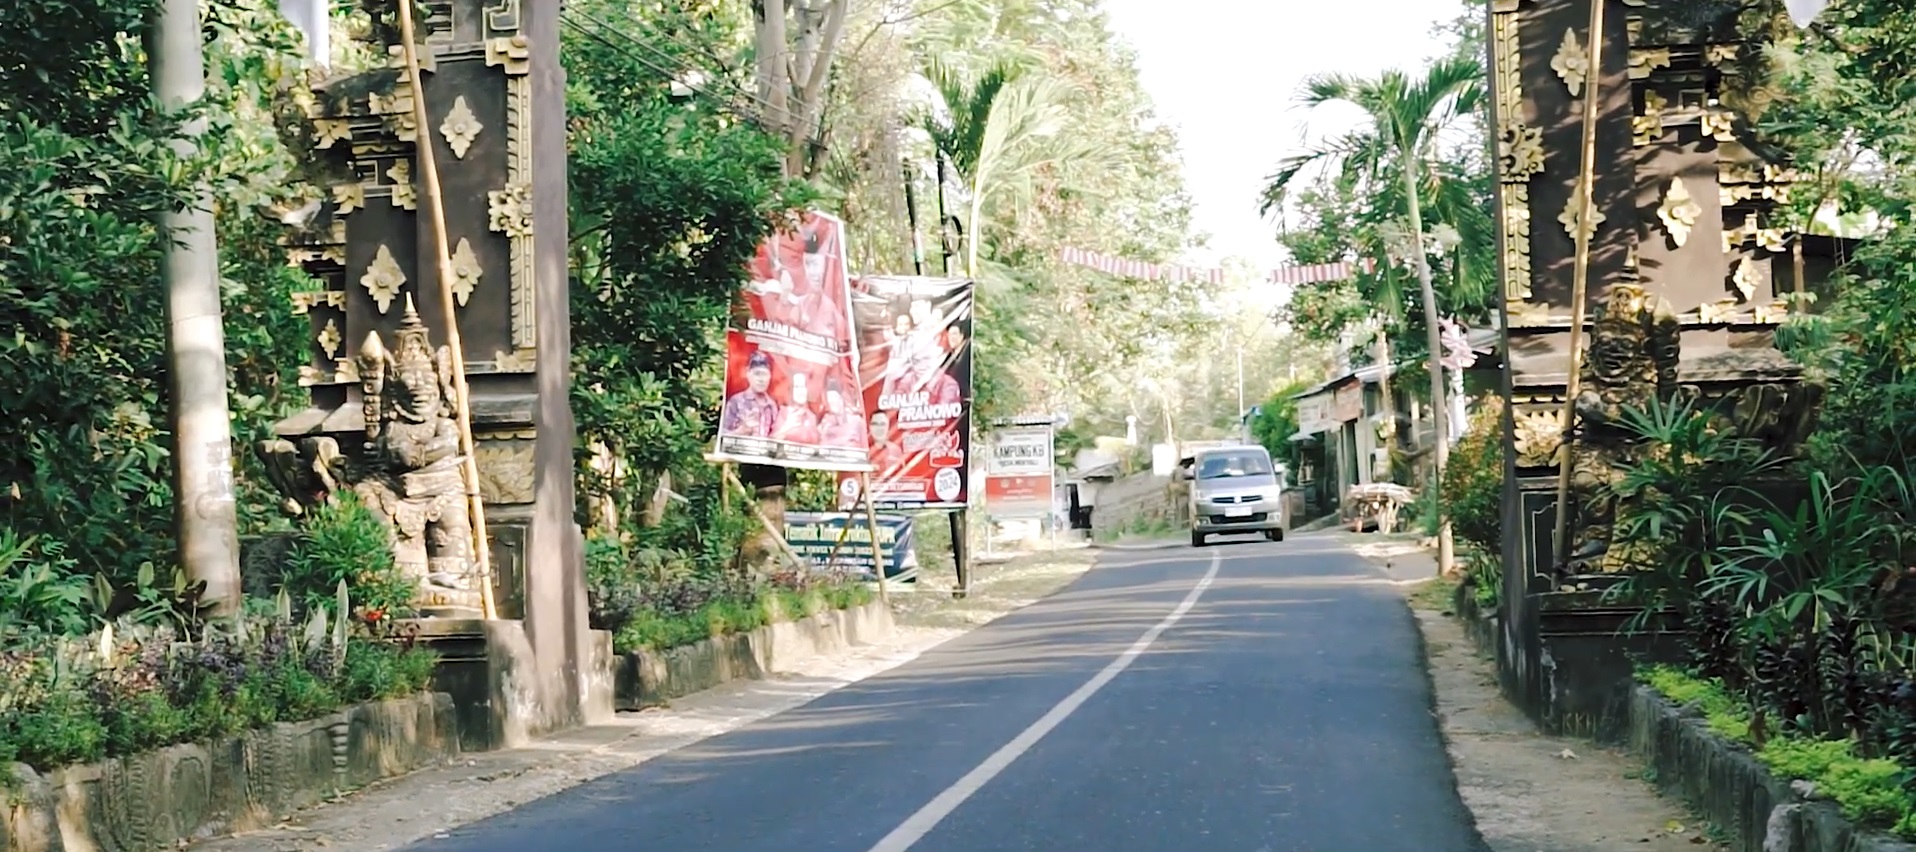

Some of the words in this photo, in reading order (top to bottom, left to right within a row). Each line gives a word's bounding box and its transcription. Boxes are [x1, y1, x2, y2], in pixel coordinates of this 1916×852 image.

[878, 391, 930, 410] GANJAR
[898, 403, 961, 421] PRANOWO
[846, 481, 855, 494] 5
[939, 476, 958, 492] 2024
